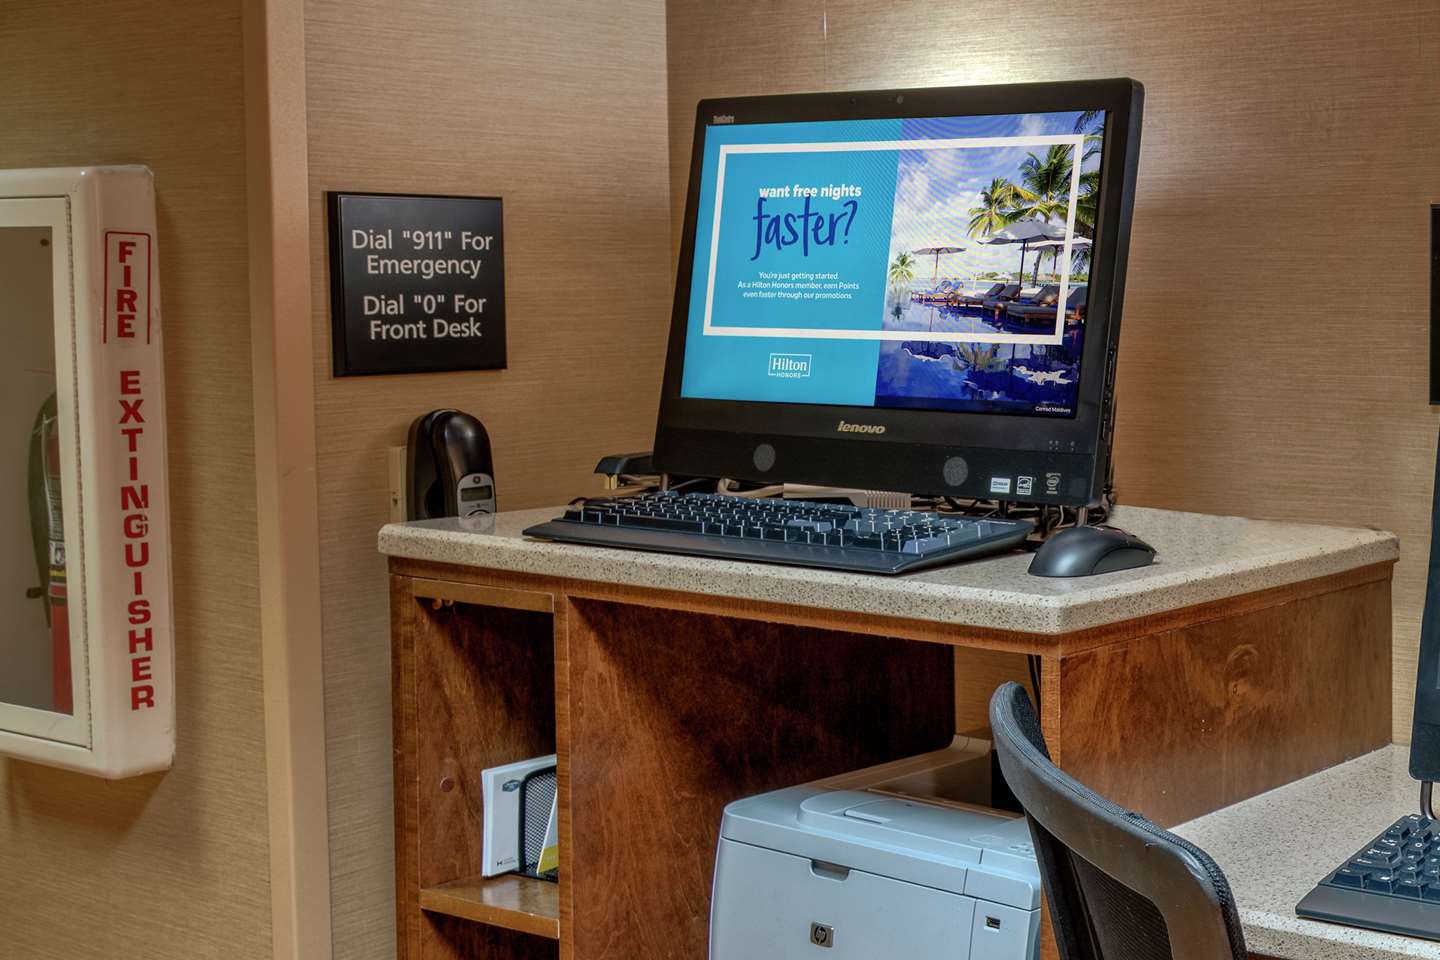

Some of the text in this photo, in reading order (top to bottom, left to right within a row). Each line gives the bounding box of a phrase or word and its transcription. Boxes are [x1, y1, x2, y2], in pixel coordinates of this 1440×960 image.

[759, 184, 862, 200] want free nights
[750, 194, 858, 261] faster?
[351, 229, 493, 250] Dial "911" For
[367, 255, 482, 279] Emergency
[116, 241, 138, 338] FIRE
[752, 281, 771, 289] Hilton
[772, 281, 794, 289] Honors
[838, 282, 860, 290] Points
[363, 294, 404, 315] Dial
[454, 294, 487, 313] For
[370, 317, 482, 340] Front Desk
[772, 357, 808, 371] Hilton
[837, 420, 886, 434] lenovo
[118, 370, 155, 711] EXTINGUISHER
